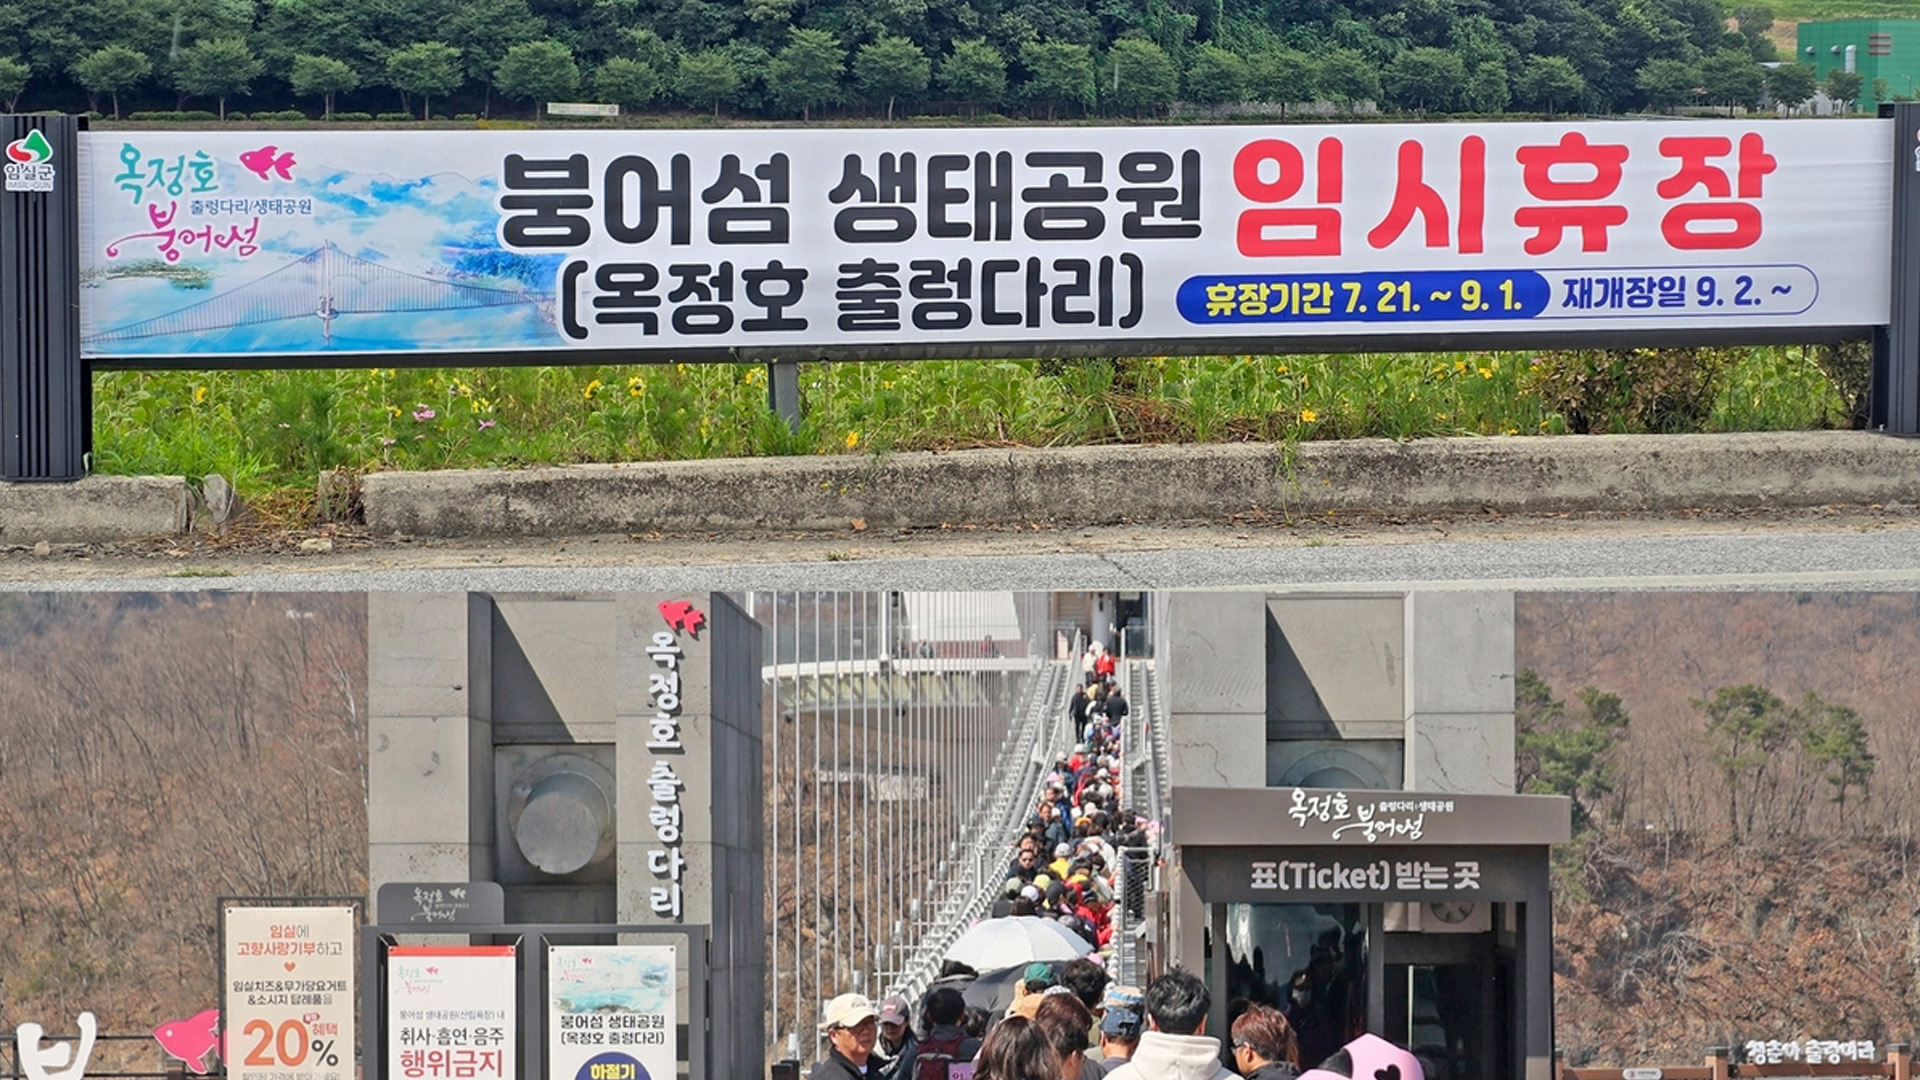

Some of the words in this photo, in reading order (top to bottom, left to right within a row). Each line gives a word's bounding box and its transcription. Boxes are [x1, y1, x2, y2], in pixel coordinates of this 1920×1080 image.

[6, 163, 53, 181] 임실군
[114, 143, 219, 205] 옥정호
[190, 199, 312, 215] 출렁다리/생태공원
[501, 152, 791, 248] 붕어섬
[828, 149, 1202, 242] 생태공원
[1232, 131, 1778, 258] 임시휴장
[106, 200, 260, 262] 붕어섬
[562, 258, 809, 340] (옥정호
[835, 252, 1143, 331] 출렁다리)
[1205, 281, 1334, 317] 휴장기간
[1341, 281, 1367, 314] 7.
[1376, 281, 1421, 314] 21.
[1460, 280, 1490, 313] 9.
[1498, 280, 1522, 312] 1.
[1562, 276, 1687, 310] 재개장일
[1696, 276, 1723, 309] 9.
[1734, 275, 1762, 308] 2.
[645, 631, 682, 749] 옥정호
[1288, 787, 1351, 828] 옥정호
[1331, 803, 1424, 843] 붕어섬
[645, 759, 684, 917] 출렁다리
[1250, 860, 1391, 891] 표(Ticket)
[1395, 861, 1450, 890] 받는
[1453, 861, 1481, 890] 곳
[270, 924, 310, 939] 임실에
[237, 941, 343, 956] 고향사랑기부하고
[232, 980, 347, 992] 임실치즈&무가당요거트
[247, 994, 288, 1005] &소시지
[560, 1015, 603, 1029] 붕어섬
[608, 1014, 665, 1029] 생태공원
[400, 1049, 503, 1078] 행위금지
[590, 1063, 636, 1080] 하절기
